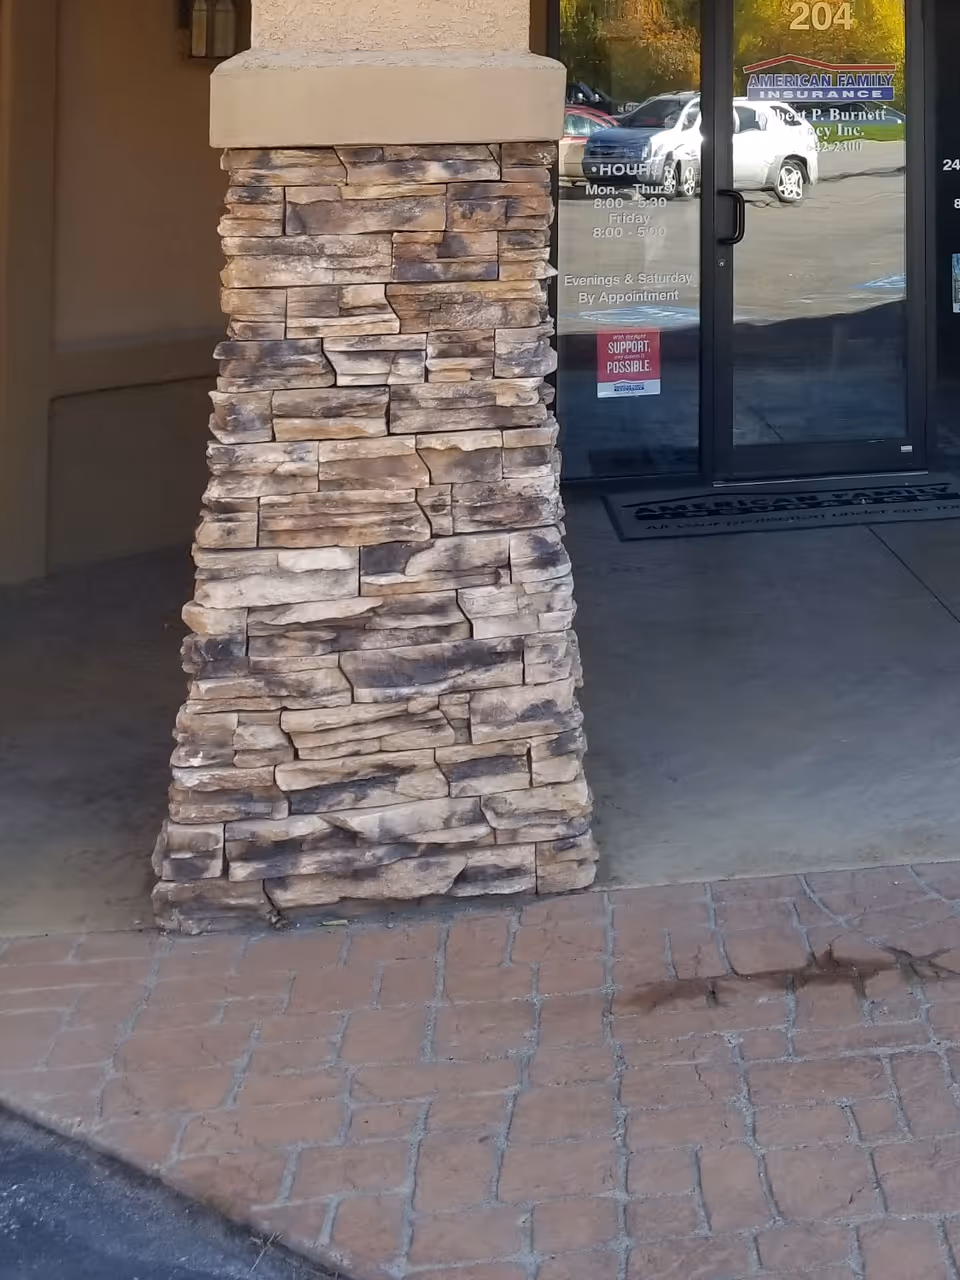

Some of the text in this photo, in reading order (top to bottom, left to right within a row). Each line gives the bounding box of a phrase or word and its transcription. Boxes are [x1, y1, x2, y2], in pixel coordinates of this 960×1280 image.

[789, 1, 853, 31] 204
[749, 74, 894, 88] AMERICAN FAMILY
[760, 90, 882, 98] INSURANCE
[812, 109, 824, 121] P.
[829, 108, 887, 121] Burnett
[837, 123, 864, 136] Inc.
[585, 184, 619, 195] Mon.
[593, 198, 624, 209] 8:00
[637, 197, 667, 208] 5:30
[609, 213, 651, 225] Friday
[592, 227, 623, 238] 8:00
[564, 272, 693, 287] Evenings & Saturday
[578, 289, 679, 305] By Appointment
[607, 360, 652, 374] POSSIBLE.
